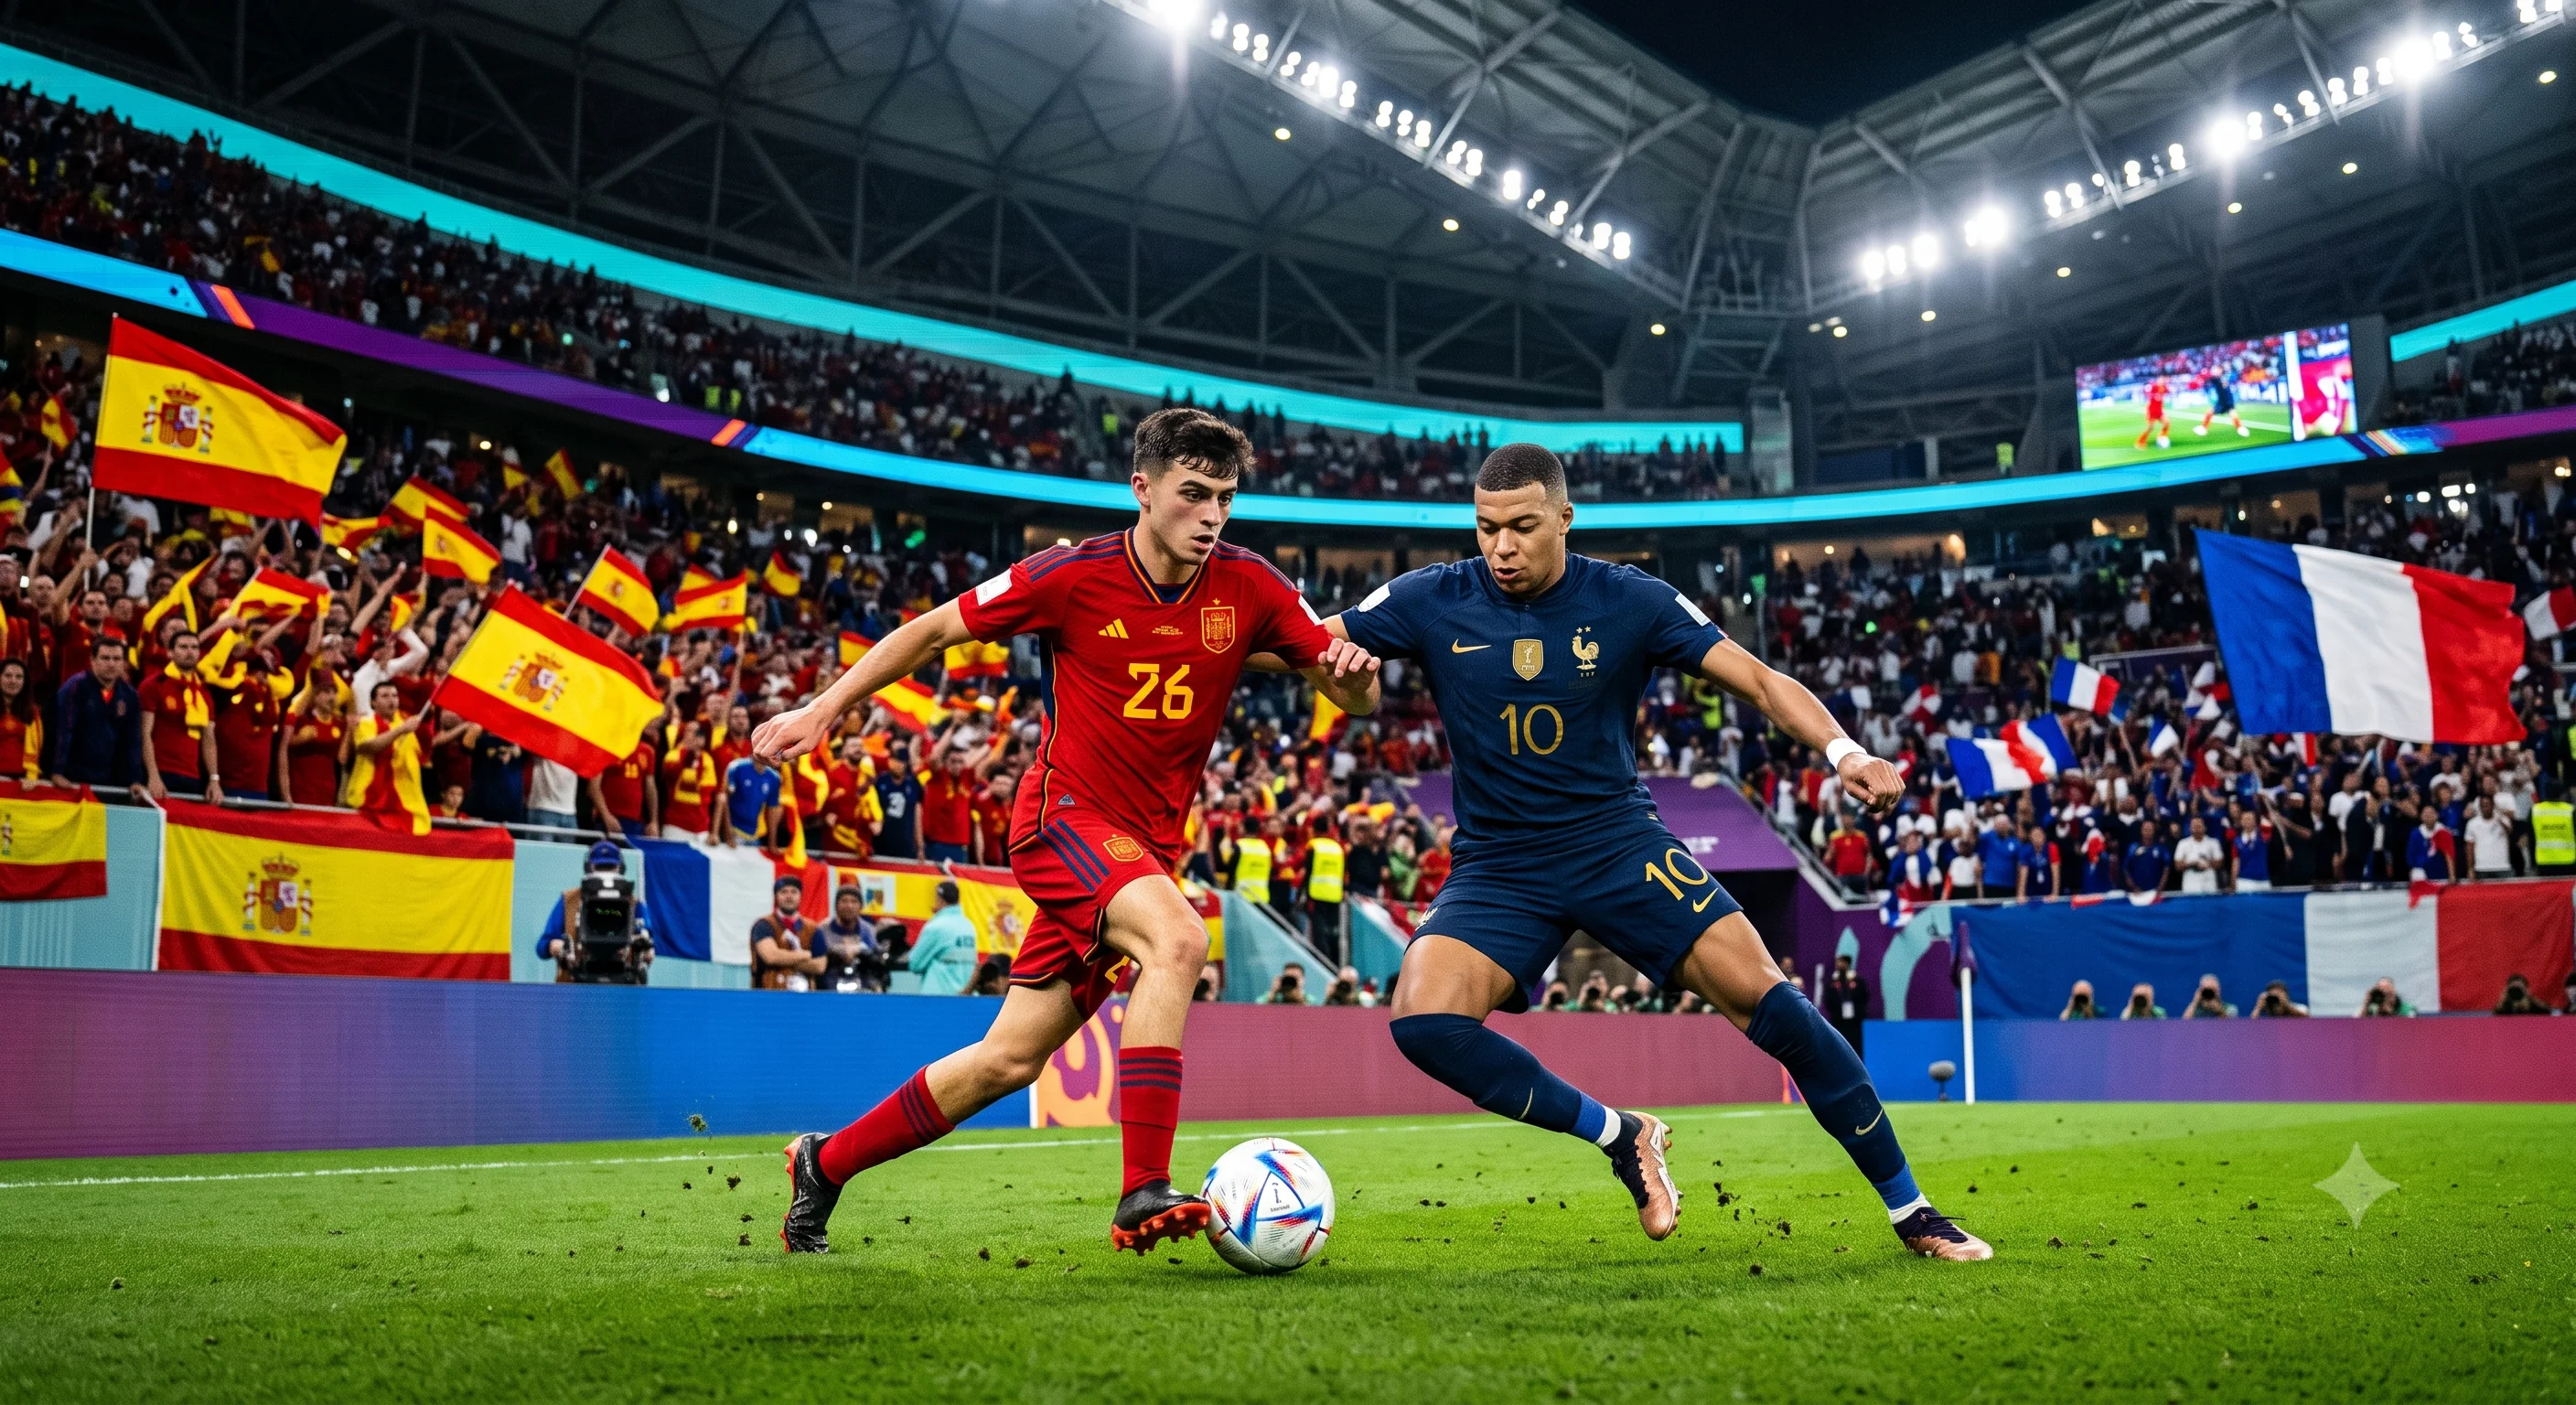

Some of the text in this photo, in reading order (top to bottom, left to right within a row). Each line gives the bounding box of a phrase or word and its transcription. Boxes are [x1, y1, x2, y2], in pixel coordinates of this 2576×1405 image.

[1123, 662, 1194, 720] 26
[1499, 703, 1563, 756] 10
[1645, 848, 1709, 901] 10
